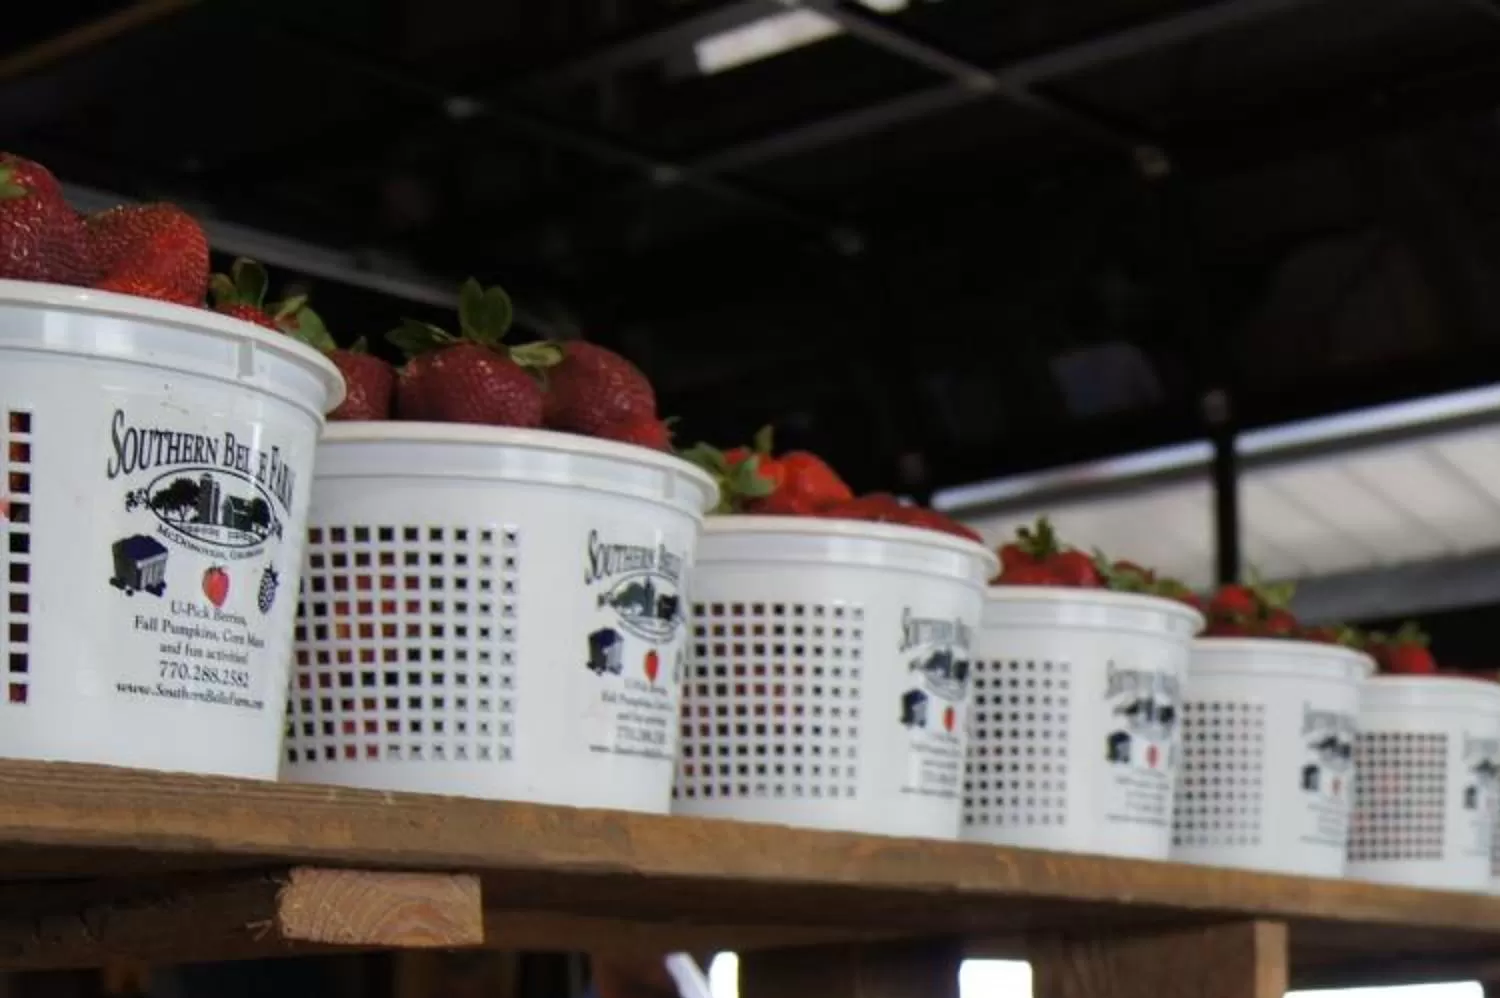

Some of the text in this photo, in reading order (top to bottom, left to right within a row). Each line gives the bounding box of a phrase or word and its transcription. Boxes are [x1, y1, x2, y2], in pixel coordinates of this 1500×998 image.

[107, 409, 219, 480] SOUTHERN
[223, 431, 268, 484] BELE
[134, 614, 158, 633] Fall
[159, 640, 181, 655] and
